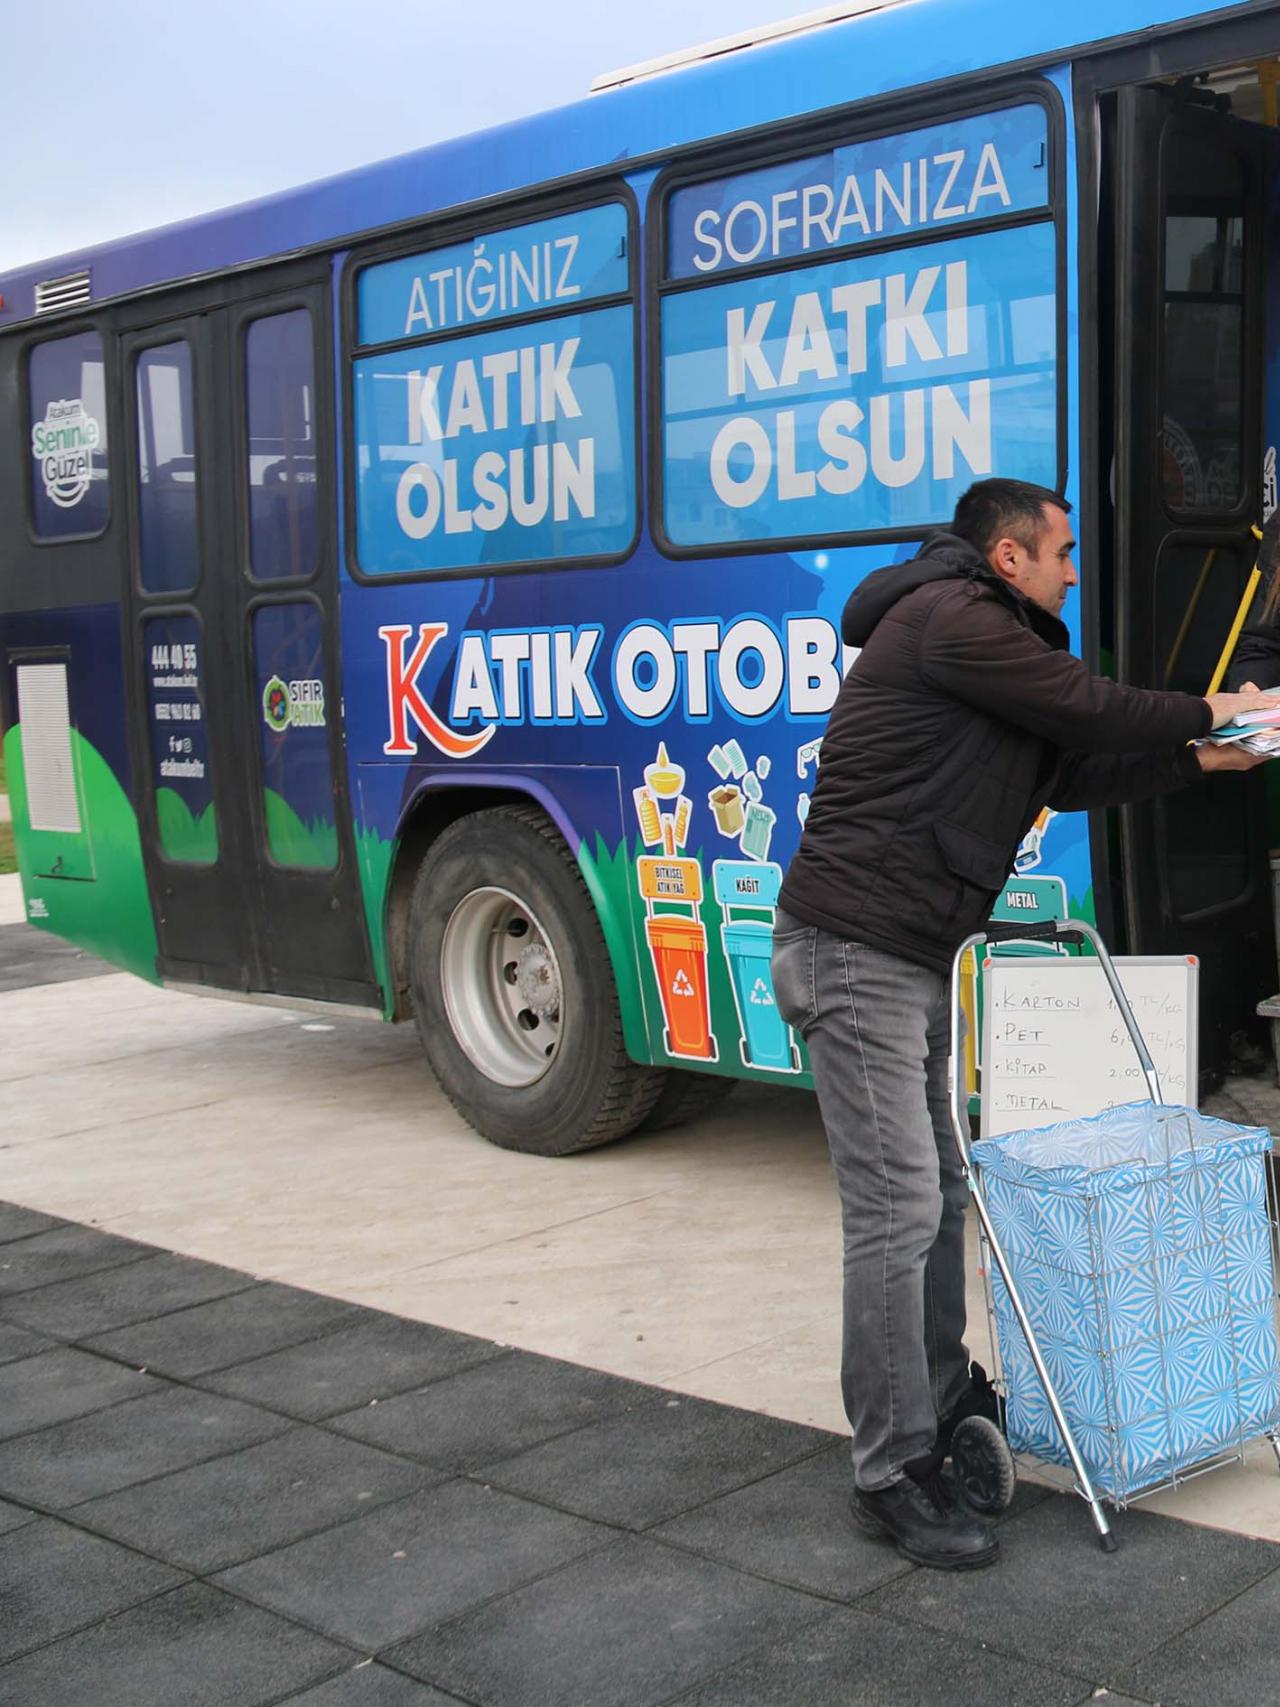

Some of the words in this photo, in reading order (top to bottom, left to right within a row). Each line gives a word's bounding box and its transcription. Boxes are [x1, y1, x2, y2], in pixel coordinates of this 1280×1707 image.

[692, 143, 1011, 271] SOFRANIZA
[404, 235, 581, 334] ATIĞINIZ
[726, 260, 968, 396] KATKI
[408, 337, 582, 445] KATIK
[396, 437, 596, 540] OLSUN
[710, 378, 992, 508] OLSUN
[291, 682, 322, 701] SIFIR
[379, 621, 605, 759] KATIK
[657, 881, 671, 893] ATIK
[736, 875, 760, 894] KAĞIT
[1006, 891, 1039, 909] METAL
[1003, 985, 1080, 1009] KARTON
[1005, 1022, 1045, 1041] PET
